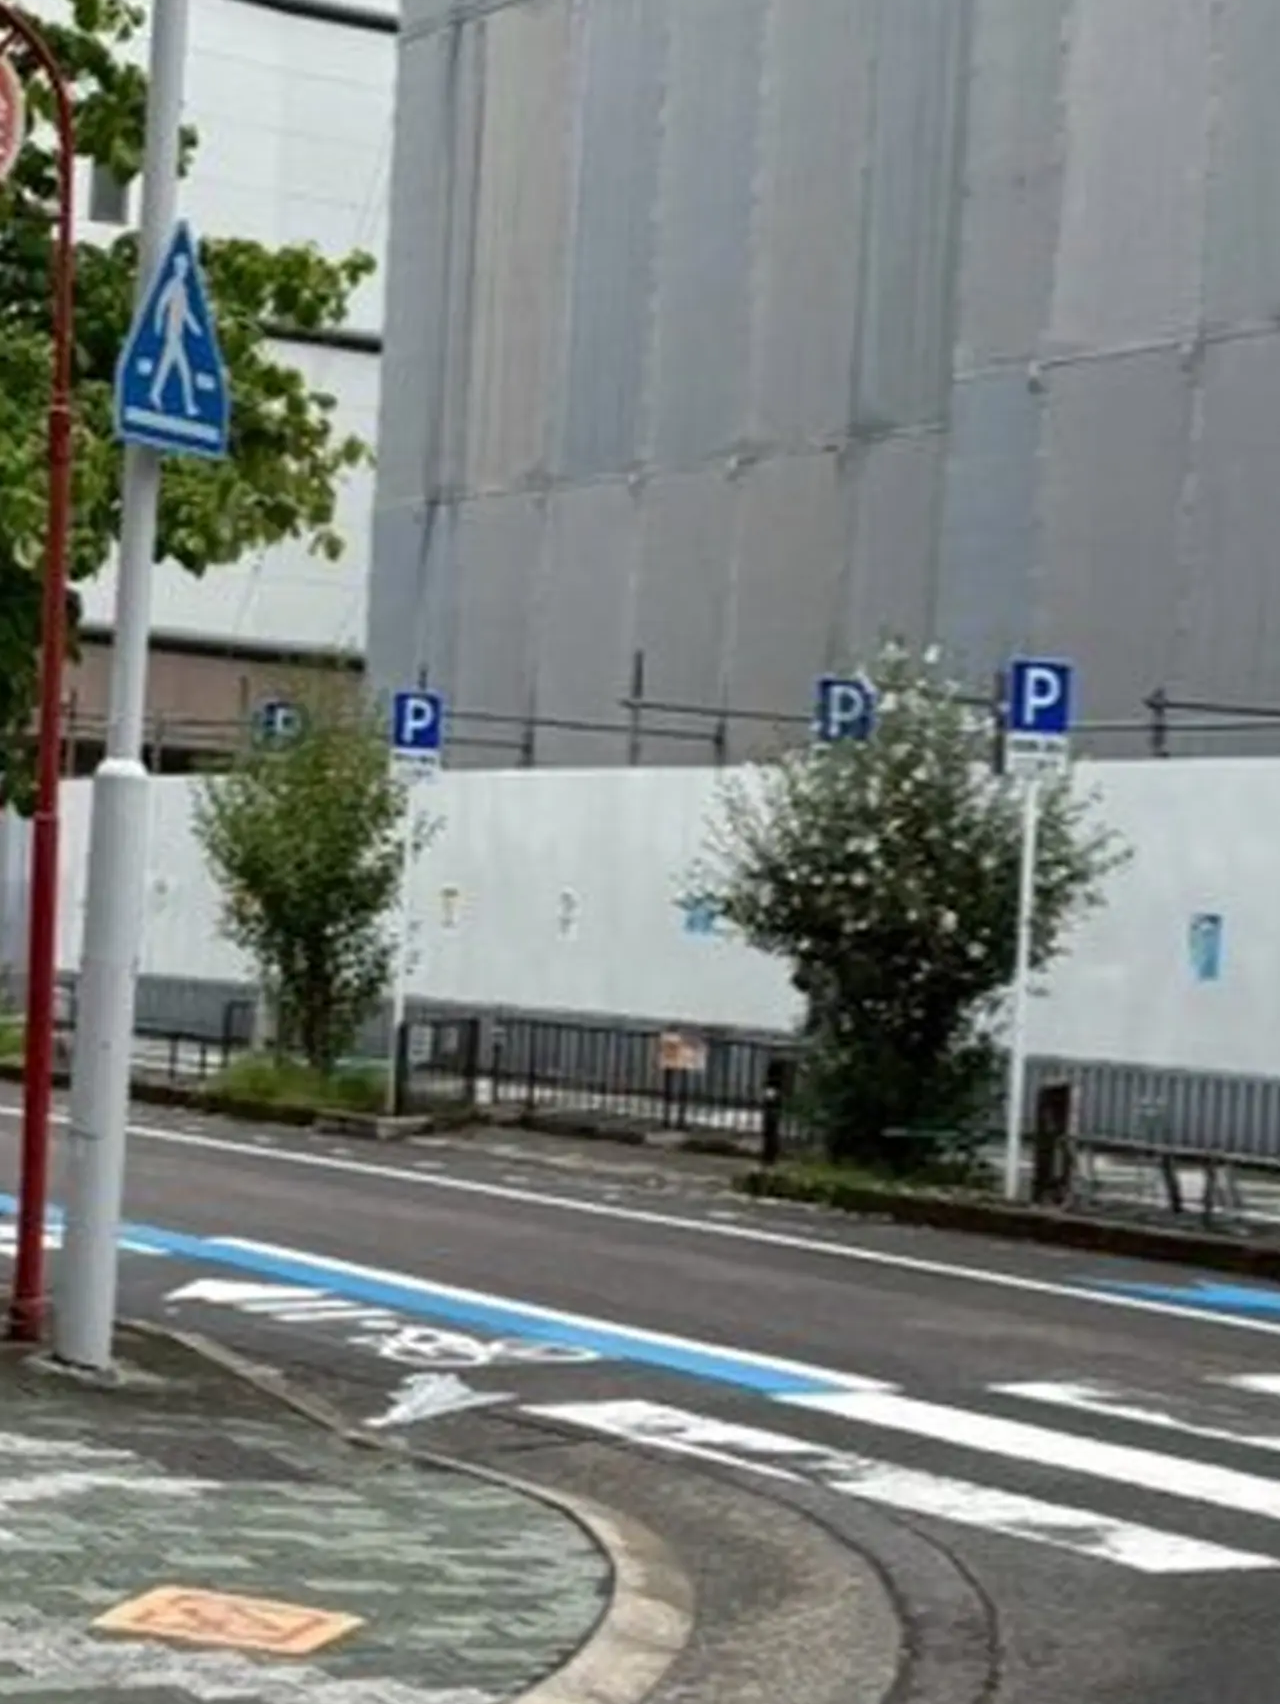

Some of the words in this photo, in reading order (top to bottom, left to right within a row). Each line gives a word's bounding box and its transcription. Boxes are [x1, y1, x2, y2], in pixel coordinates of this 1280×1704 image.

[403, 697, 433, 743] P
[828, 684, 864, 737] P
[1023, 667, 1061, 725] P
